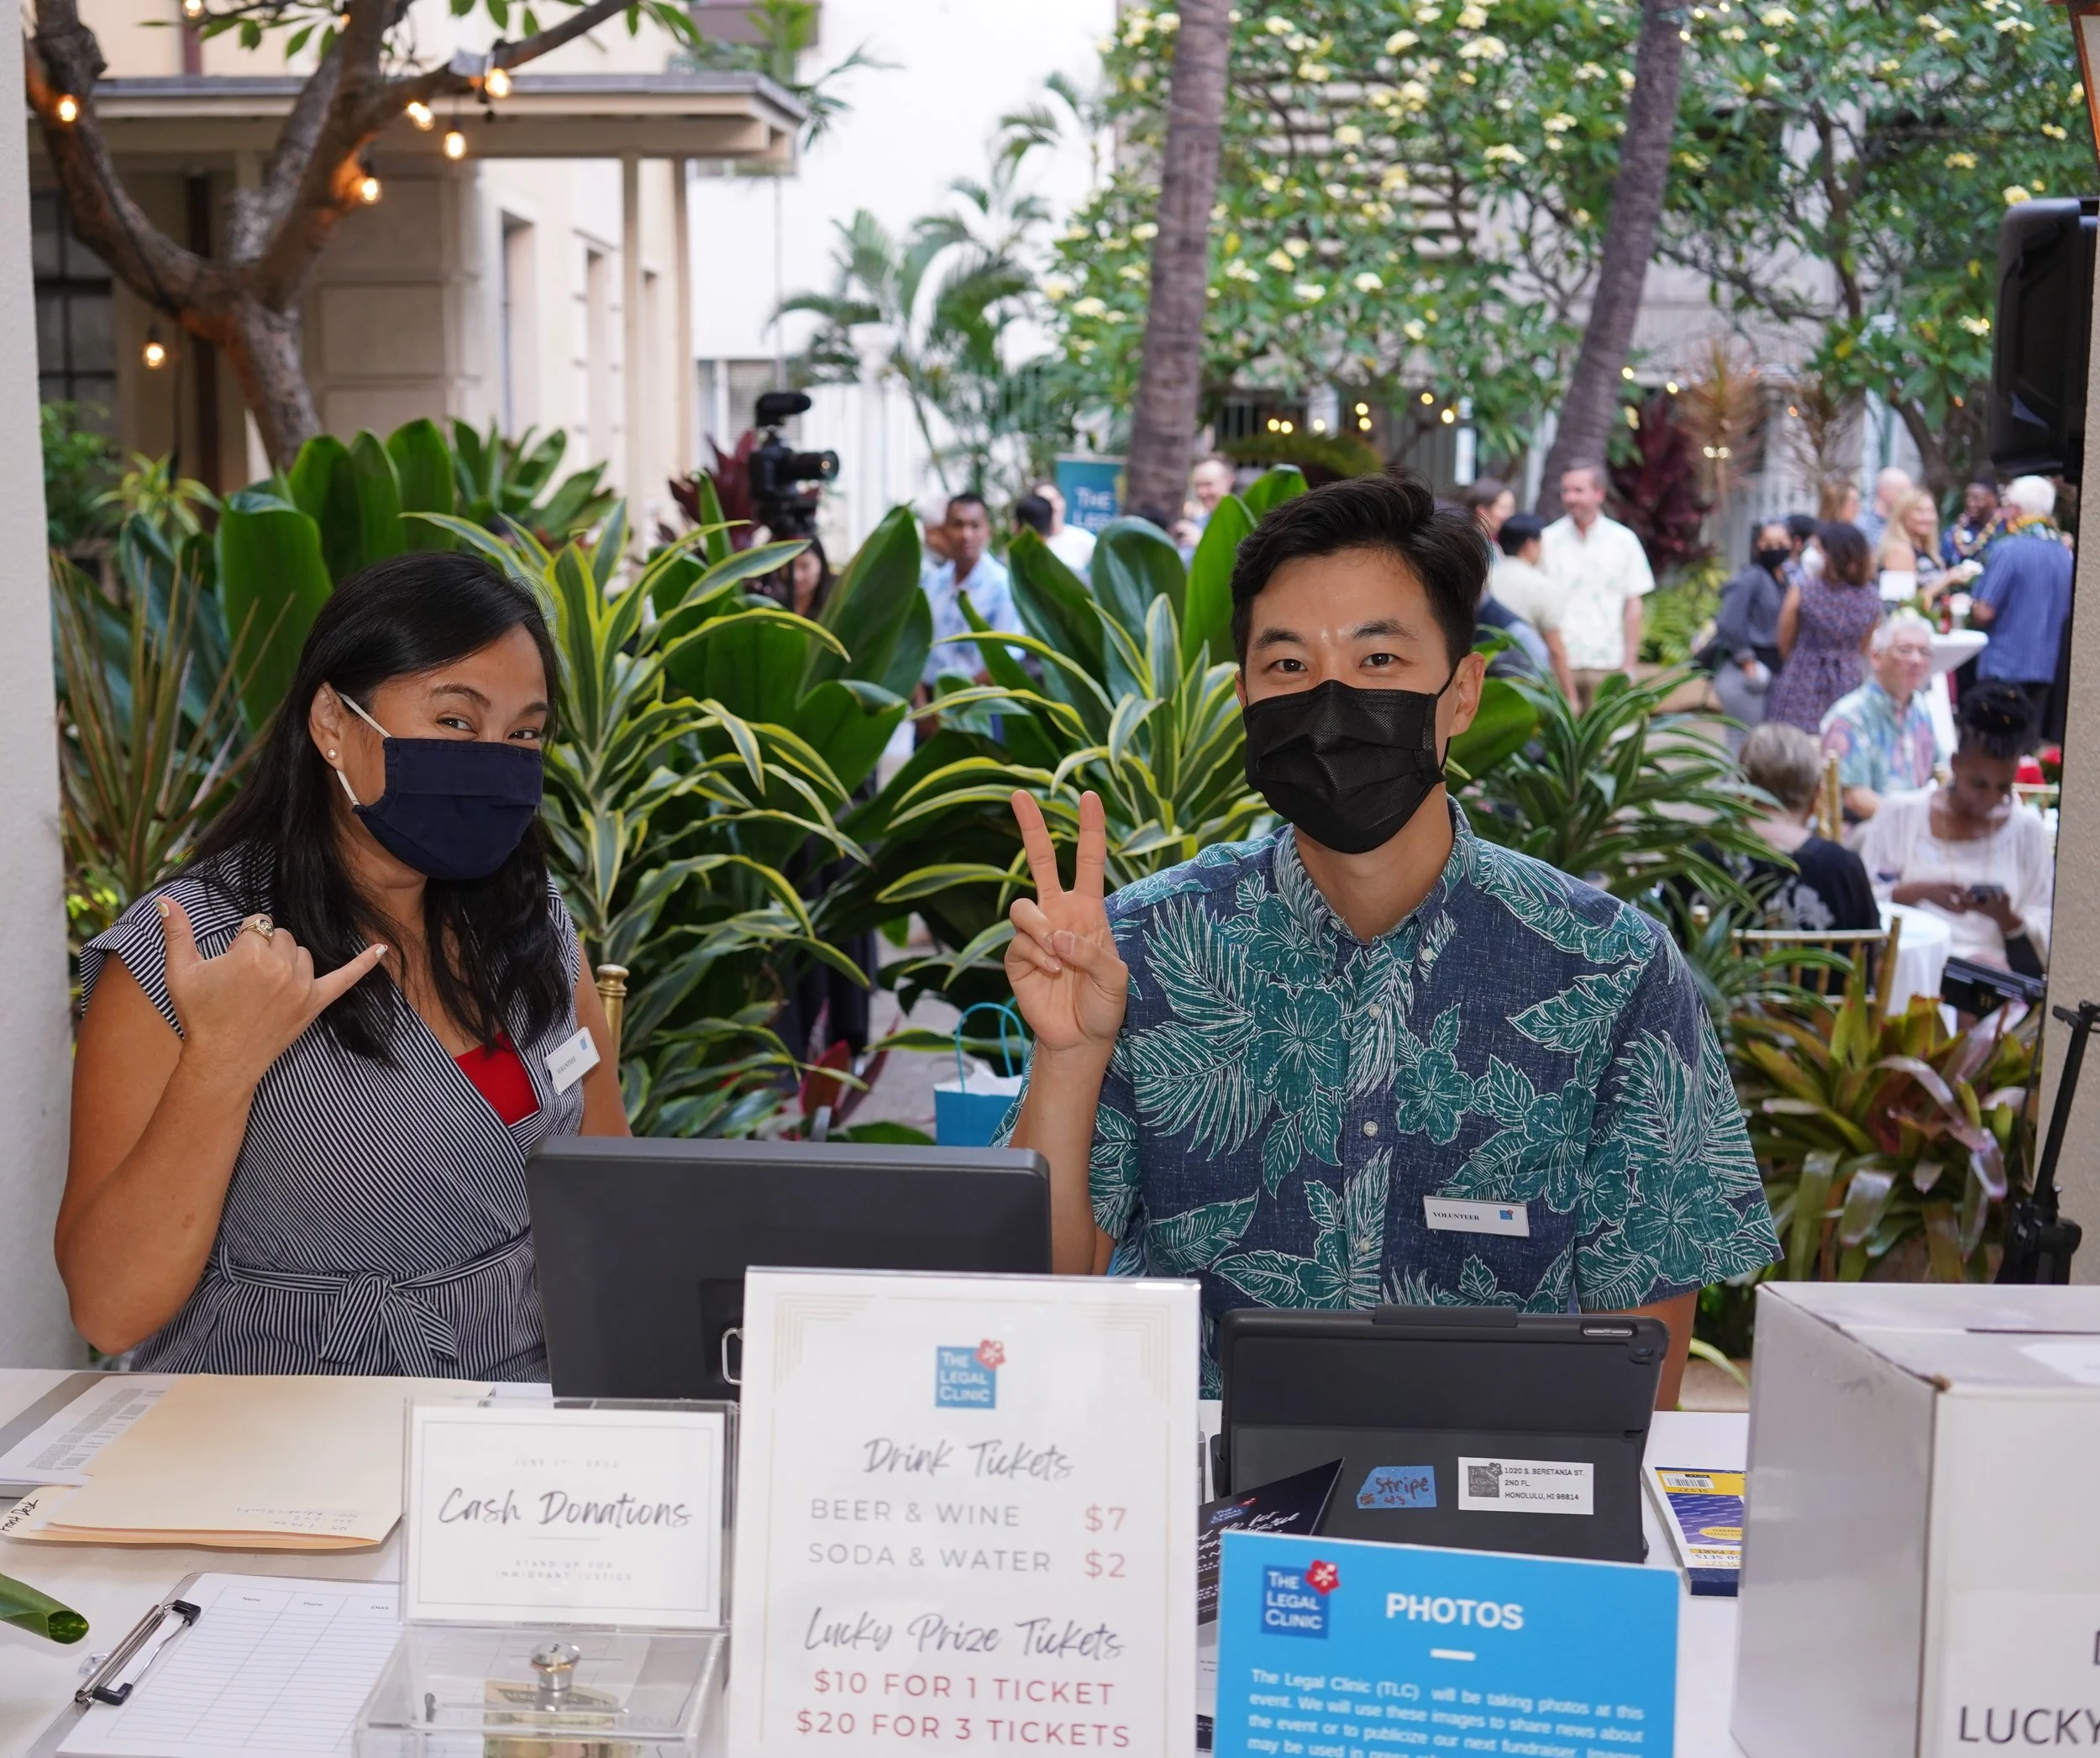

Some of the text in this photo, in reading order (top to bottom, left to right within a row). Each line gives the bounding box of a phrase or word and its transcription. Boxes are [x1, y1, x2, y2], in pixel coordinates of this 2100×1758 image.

[1432, 1211, 1480, 1221] VOLUNTEER
[863, 1437, 1074, 1481] Drink Tickets
[438, 1487, 693, 1529] Cash Donations
[810, 1498, 1127, 1534] BEER & WINE $7
[807, 1542, 1126, 1579] SODA & WATER $2
[1267, 1571, 1300, 1590] THE
[1265, 1608, 1323, 1629] CLINIC
[1266, 1591, 1320, 1611] LEGAL
[1385, 1592, 1525, 1630] PHOTOS
[804, 1607, 1126, 1661] Lucky Prize Tickets
[814, 1667, 1115, 1706] $10 FOR 1 TICKET
[1251, 1668, 1646, 1721] The Legal Clinic (TLC) will be taking photos at this
[795, 1708, 1131, 1748] $20 FOR 3 TICKETS
[1248, 1713, 1273, 1729] the
[1276, 1719, 1319, 1734] event
[1322, 1724, 1339, 1735] or
[1342, 1724, 1360, 1738] to
[1362, 1727, 1429, 1745] publicize
[1433, 1734, 1459, 1748] our
[1463, 1737, 1497, 1751] next
[1249, 1693, 1644, 1744] event. We will use these images to share news about
[1959, 1705, 2100, 1746] LUCKY
[1247, 1738, 1279, 1755] may
[1284, 1740, 1304, 1755] be
[1308, 1744, 1346, 1758] used
